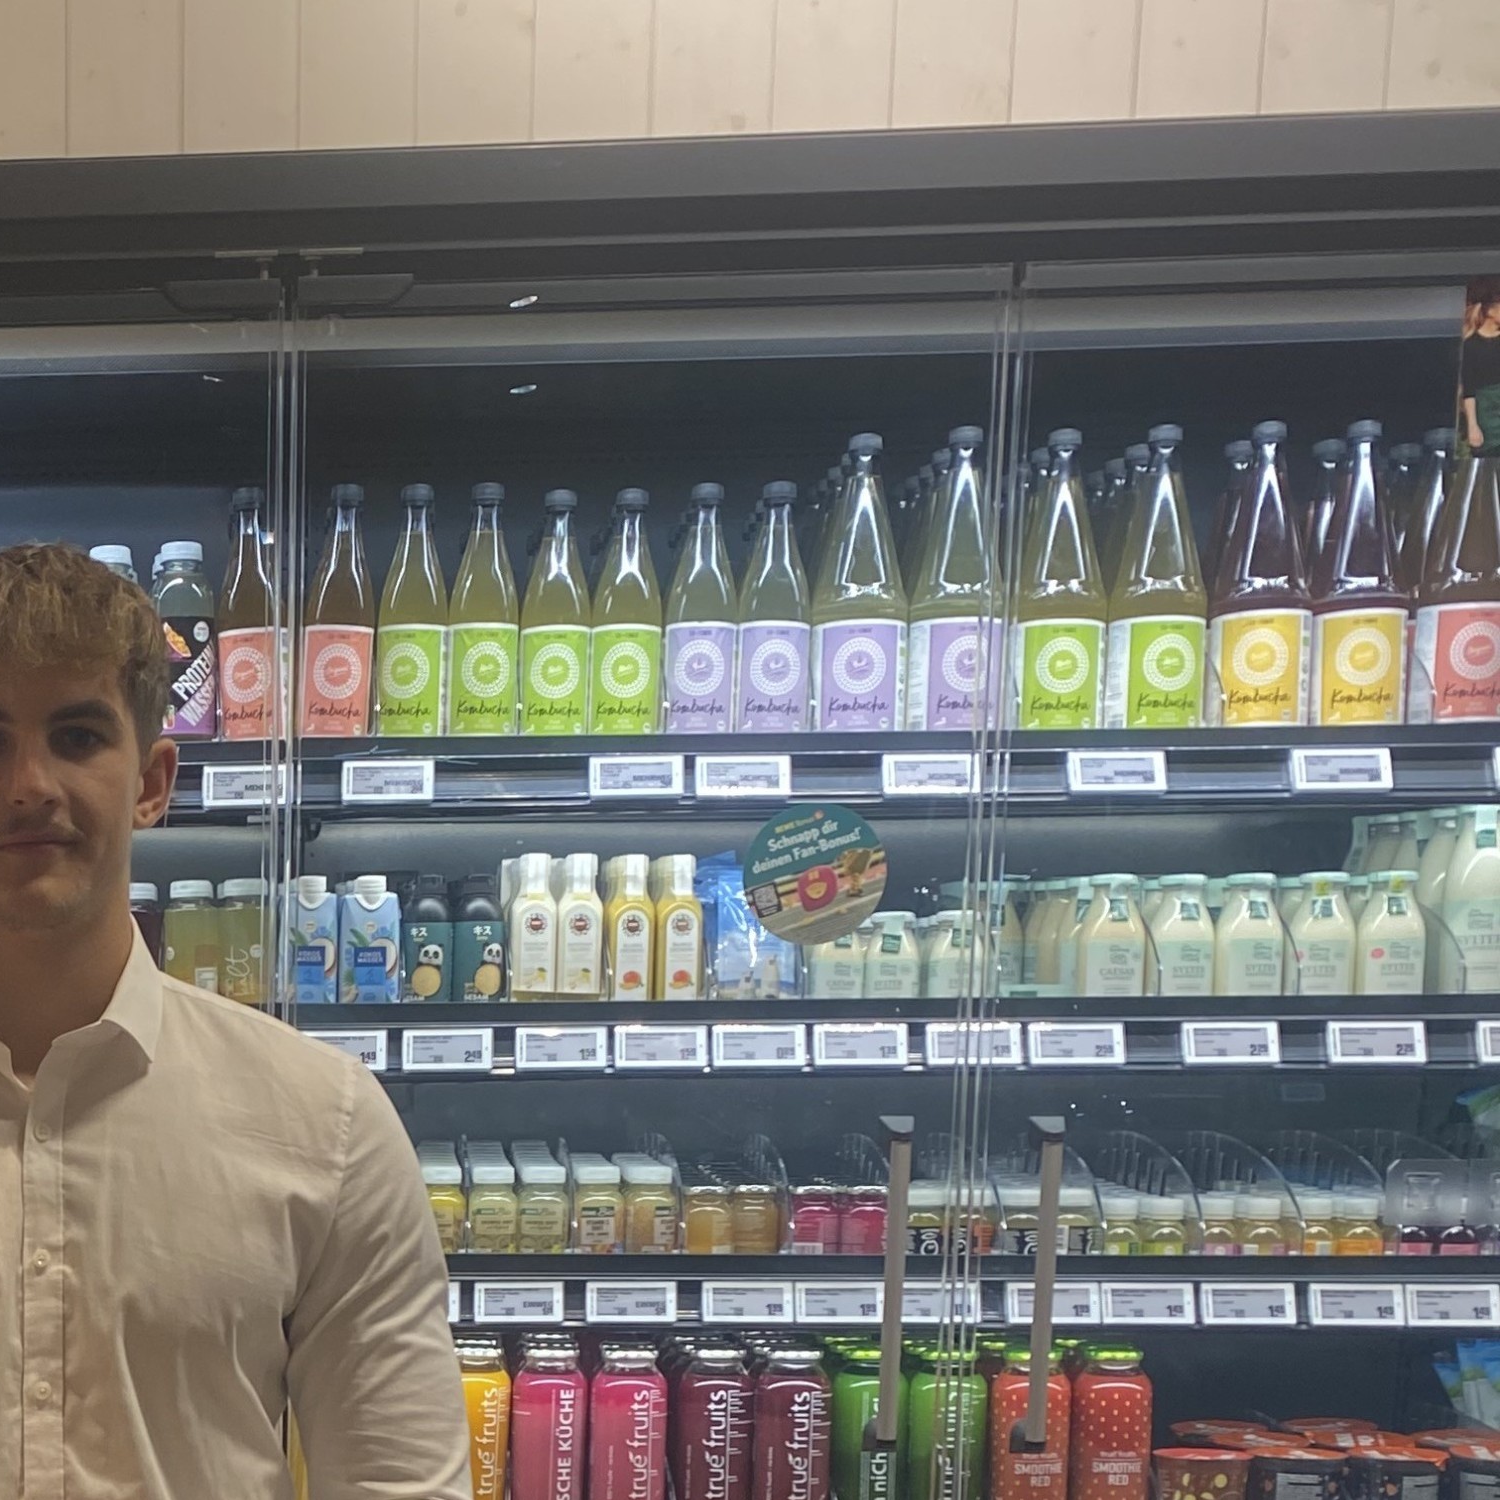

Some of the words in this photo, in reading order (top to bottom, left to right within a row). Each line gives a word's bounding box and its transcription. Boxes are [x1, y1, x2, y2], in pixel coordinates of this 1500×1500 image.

[752, 851, 793, 875] deinen
[792, 826, 863, 863] Fan-Bonus!
[766, 827, 820, 853] Schnapp
[820, 819, 840, 835] dir
[481, 1387, 499, 1444] fruits
[556, 1388, 575, 1452] KÜCHE
[627, 1389, 650, 1449] fruits
[702, 1389, 728, 1449] fruits
[785, 1391, 811, 1451] fruits
[476, 1447, 495, 1497] true
[629, 1452, 649, 1500] true
[704, 1451, 725, 1500] true
[1014, 1462, 1063, 1475] SMOOTHIE
[1030, 1475, 1051, 1487] RED
[1092, 1461, 1143, 1474] SMOOTHIE
[1107, 1474, 1129, 1486] RED
